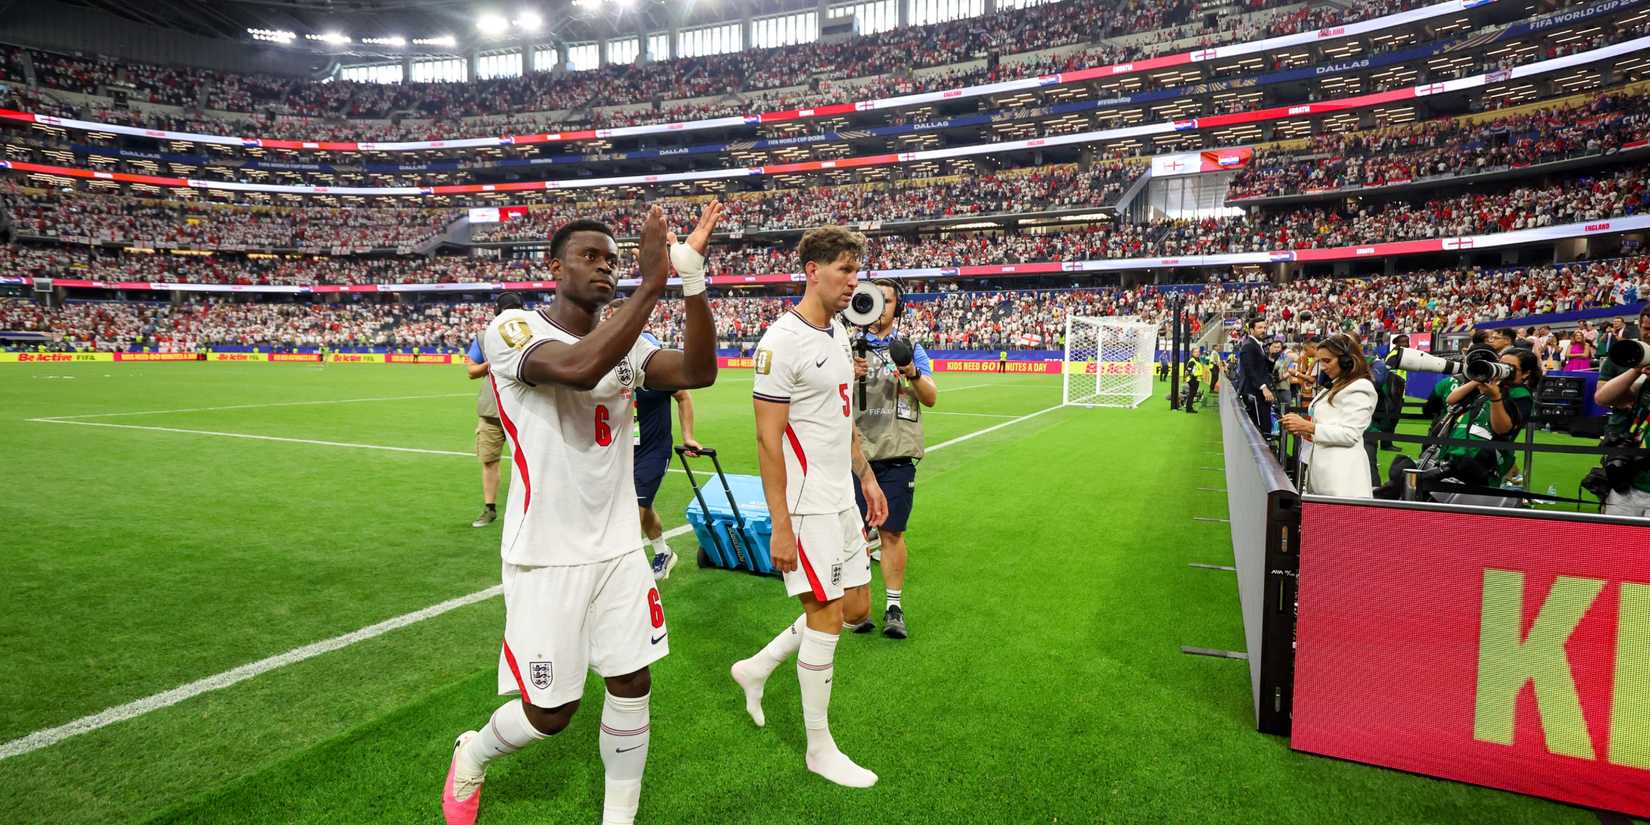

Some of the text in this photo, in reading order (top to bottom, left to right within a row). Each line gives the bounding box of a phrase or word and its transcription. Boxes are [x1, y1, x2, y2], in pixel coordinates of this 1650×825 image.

[1529, 18, 1553, 30] FIFA
[1554, 8, 1595, 24] WORLD
[1596, 1, 1619, 13] CUP
[1316, 59, 1370, 74] DALLAS
[913, 120, 949, 130] DALLAS
[119, 150, 161, 159] DALLAS
[659, 147, 689, 156] DALLAS
[1585, 223, 1610, 232] ENGLAND
[947, 361, 962, 370] KIDS
[963, 361, 980, 370] NEED
[981, 361, 996, 370] 60
[1034, 362, 1048, 371] DAY
[839, 384, 851, 417] 5
[594, 404, 612, 447] 6
[648, 587, 664, 629] 6
